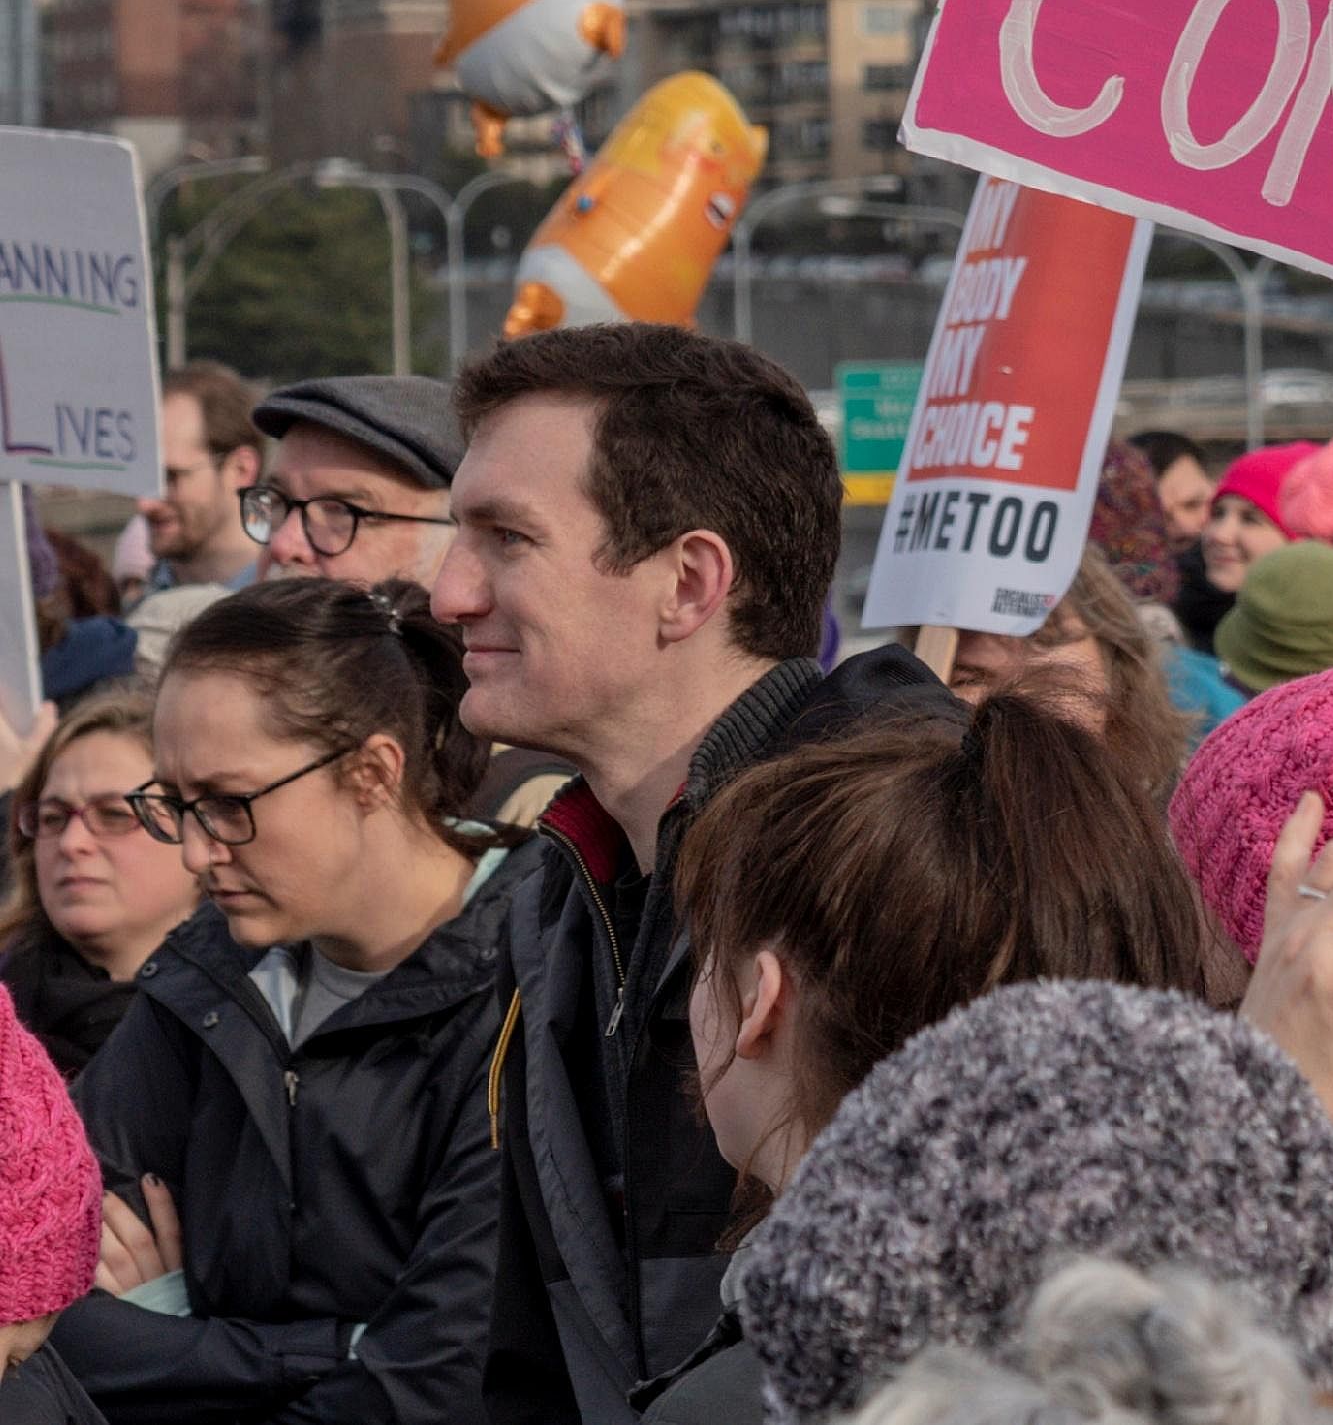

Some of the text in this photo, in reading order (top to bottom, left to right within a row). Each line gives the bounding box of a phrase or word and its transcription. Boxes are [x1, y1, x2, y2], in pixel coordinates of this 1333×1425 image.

[928, 326, 987, 399] MY
[911, 401, 1036, 471] CHOICE
[894, 490, 1059, 563] #METOO
